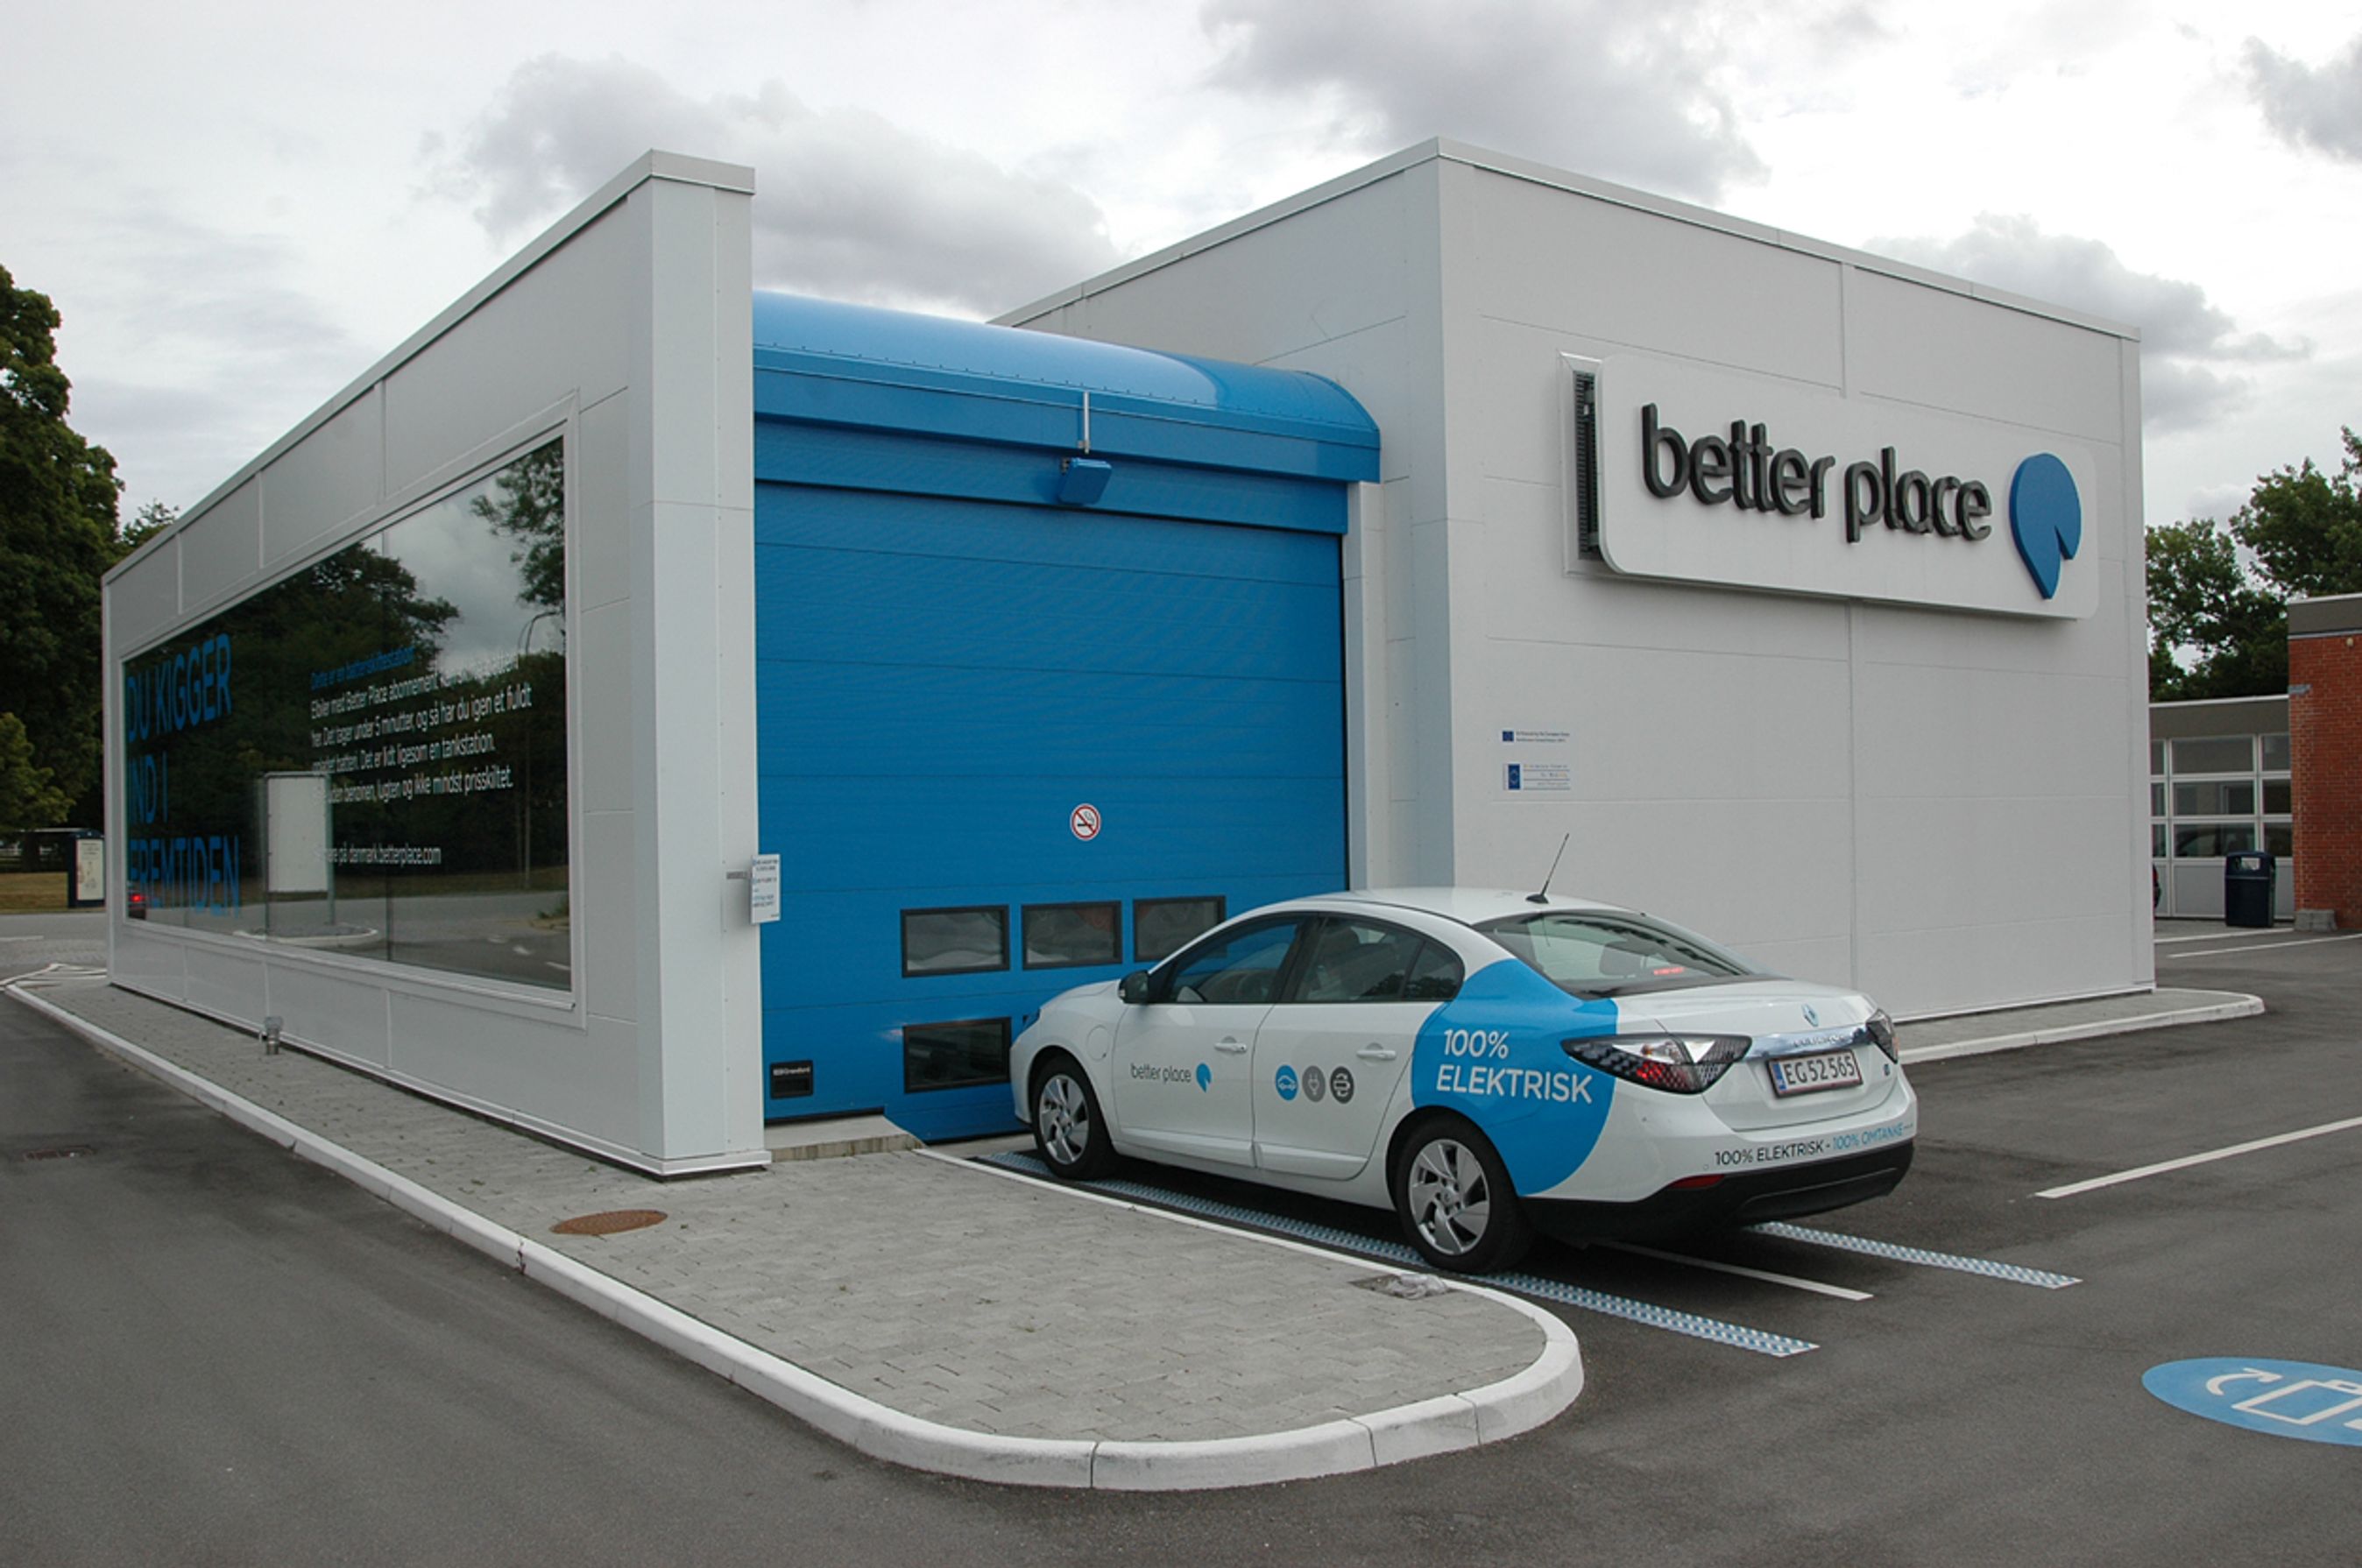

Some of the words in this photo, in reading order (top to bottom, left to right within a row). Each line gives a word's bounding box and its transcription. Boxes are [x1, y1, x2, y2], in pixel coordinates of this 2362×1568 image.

[1641, 403, 1835, 519] better
[1844, 446, 1992, 543] place
[128, 670, 150, 743] DU
[155, 633, 232, 734] KIGGER
[346, 690, 367, 710] Better
[368, 685, 387, 706] Place
[389, 672, 438, 702] abonnement
[354, 717, 373, 740] under
[375, 715, 380, 736] 5
[416, 710, 428, 732] og
[429, 700, 439, 725] så
[441, 701, 455, 724] har
[457, 696, 470, 721] du
[470, 693, 491, 723] igen
[494, 690, 505, 713] et
[506, 682, 532, 710] fuldt
[360, 749, 373, 770] Det
[374, 752, 383, 767] er
[397, 743, 428, 769] ligesom
[429, 742, 441, 760] en
[442, 730, 496, 759] tankstation.
[129, 755, 157, 824] IND
[162, 751, 168, 824] I
[402, 779, 413, 801] og
[414, 772, 432, 795] ikke
[433, 768, 462, 795] mindst
[464, 764, 514, 796] prisskiltet.
[129, 835, 240, 918] FREMTIDEN
[1444, 1028, 1510, 1059] 100%
[1130, 1063, 1161, 1080] better
[1163, 1065, 1192, 1084] place
[1436, 1063, 1593, 1104] ELEKTRISK
[1715, 1148, 1753, 1166] 100%
[1757, 1140, 1825, 1162] ELEKTRISK
[1833, 1134, 1860, 1150] 100%
[1862, 1122, 1904, 1145] OMTANKE
